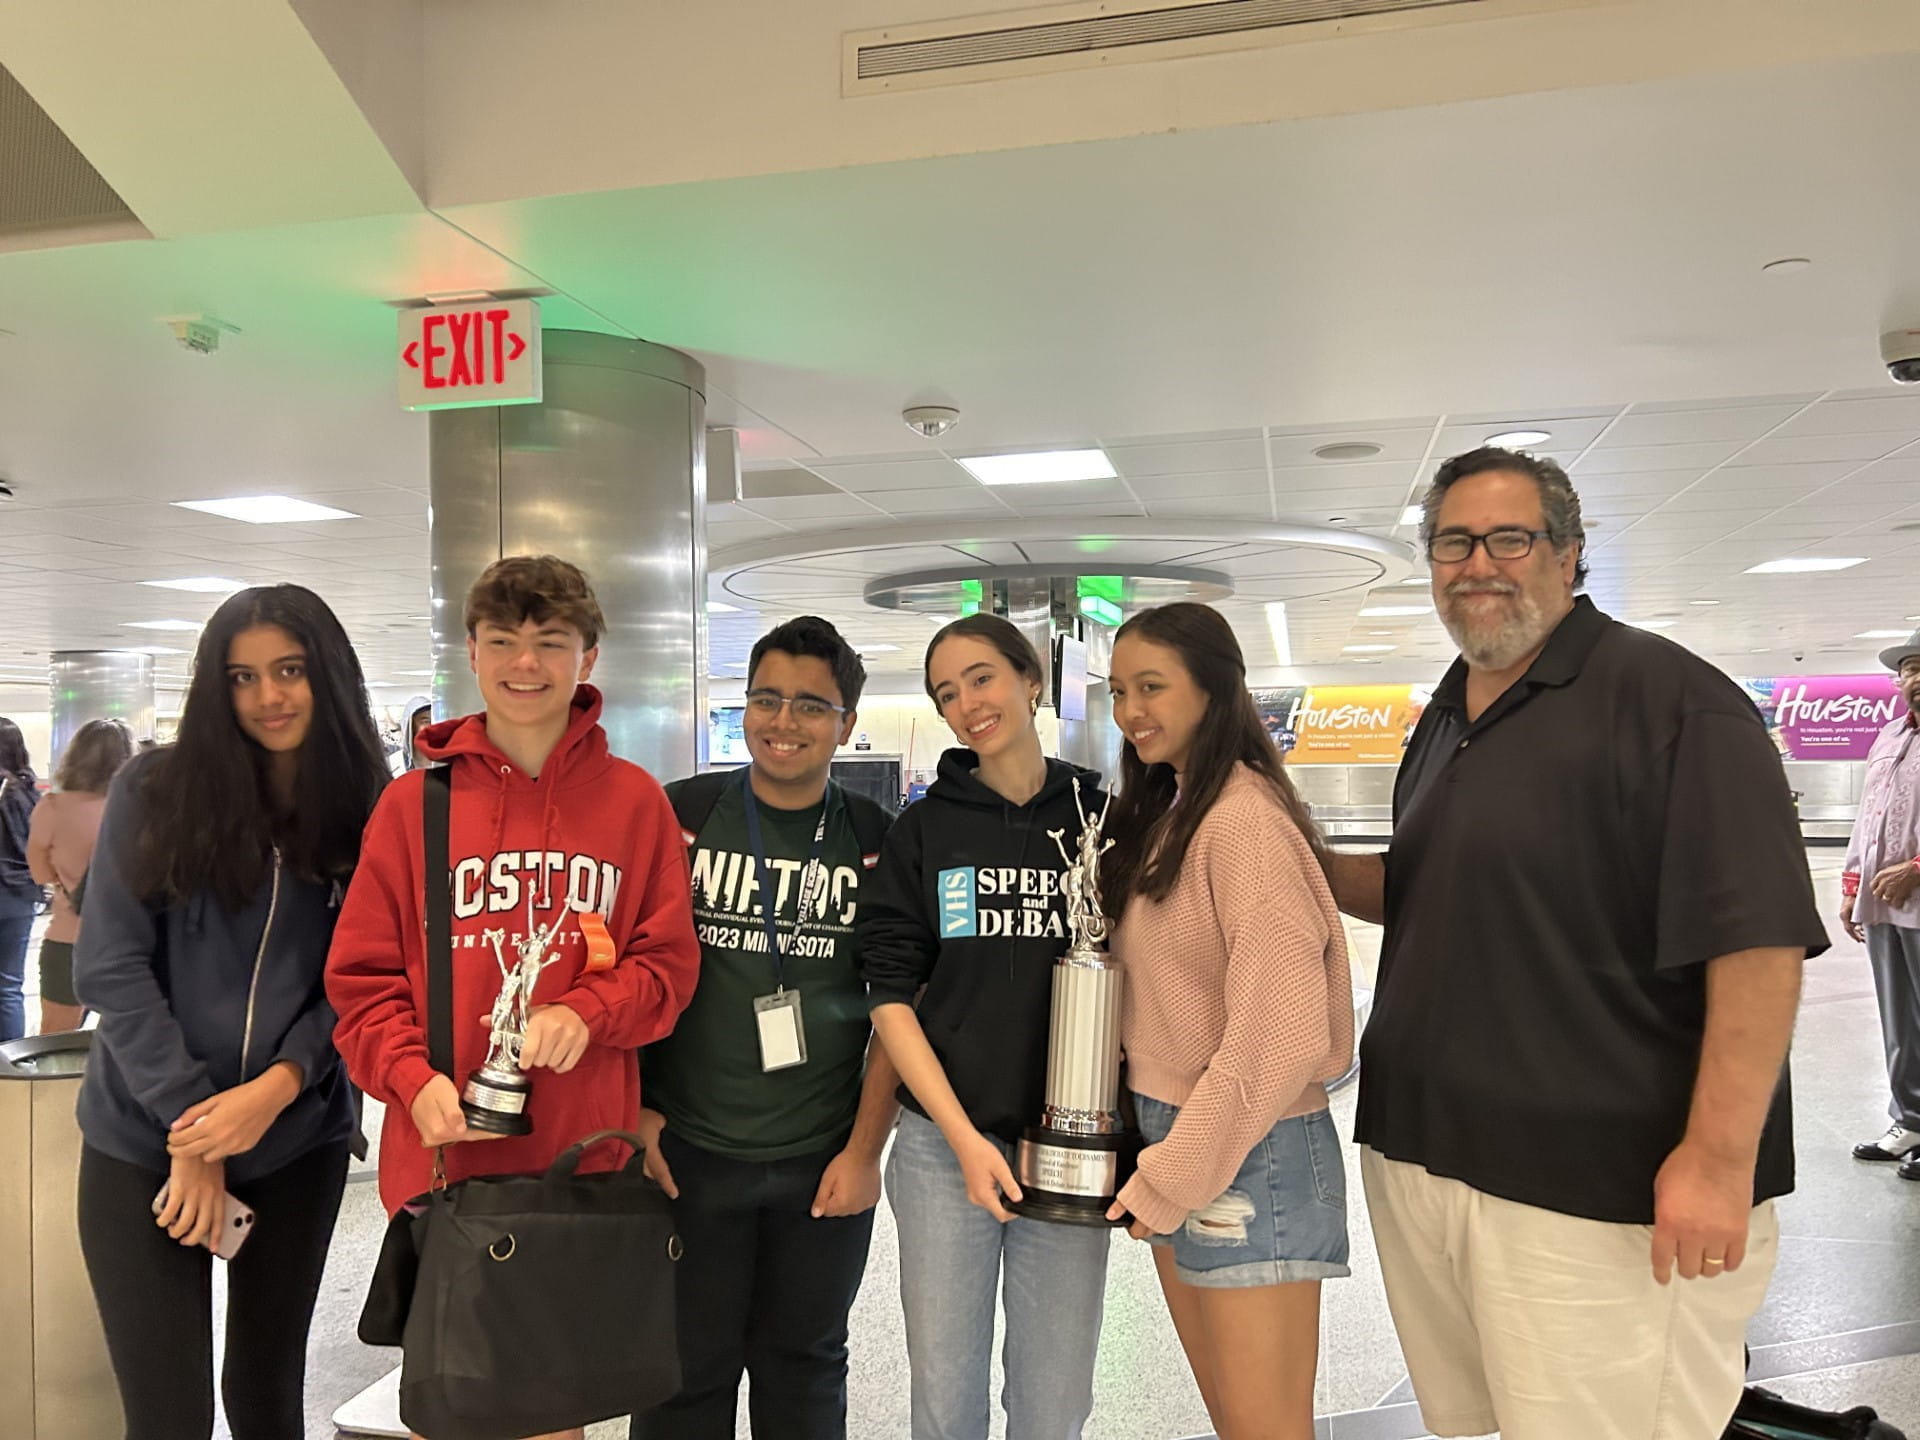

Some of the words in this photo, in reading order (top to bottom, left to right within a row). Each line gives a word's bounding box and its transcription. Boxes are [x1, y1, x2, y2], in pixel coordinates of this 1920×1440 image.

[423, 309, 510, 389] EXIT
[449, 850, 622, 925] OSTON
[977, 867, 1069, 896] SPEEC
[944, 871, 969, 933] VHS
[1022, 896, 1048, 910] and
[698, 924, 741, 950] 2023
[977, 908, 1065, 938] DEBA
